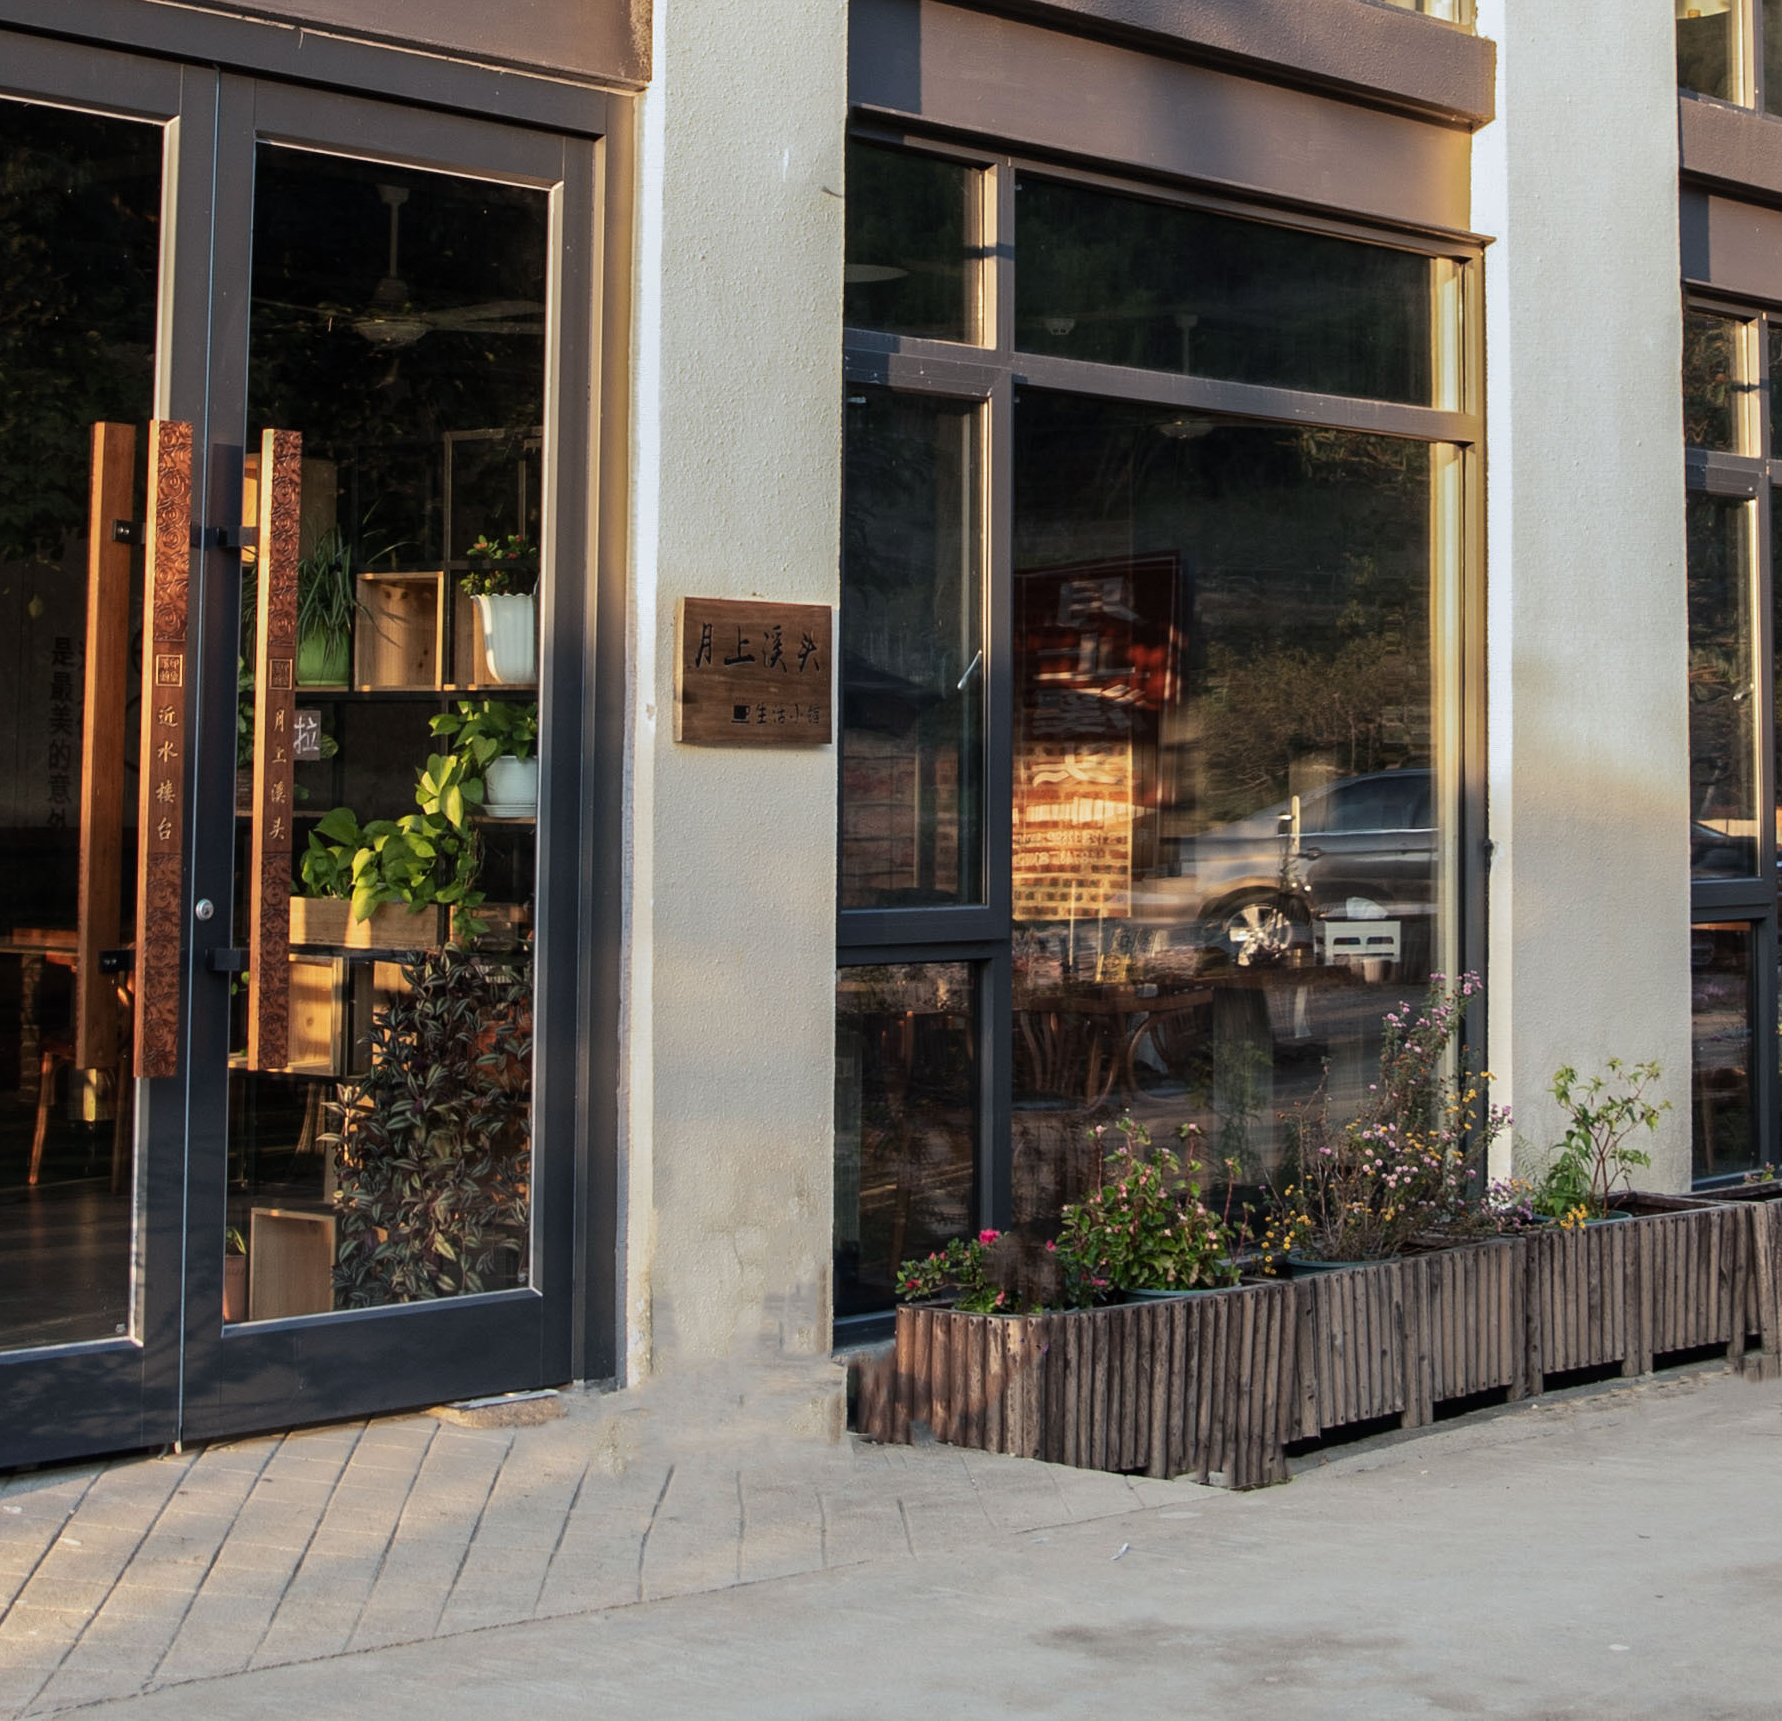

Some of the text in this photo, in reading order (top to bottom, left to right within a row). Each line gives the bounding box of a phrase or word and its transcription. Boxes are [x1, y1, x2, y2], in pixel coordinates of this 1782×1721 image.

[695, 623, 820, 673] 月上溪头
[155, 705, 179, 841] 近水楼台
[269, 709, 287, 840] 月上溪头
[293, 714, 319, 756] 拉
